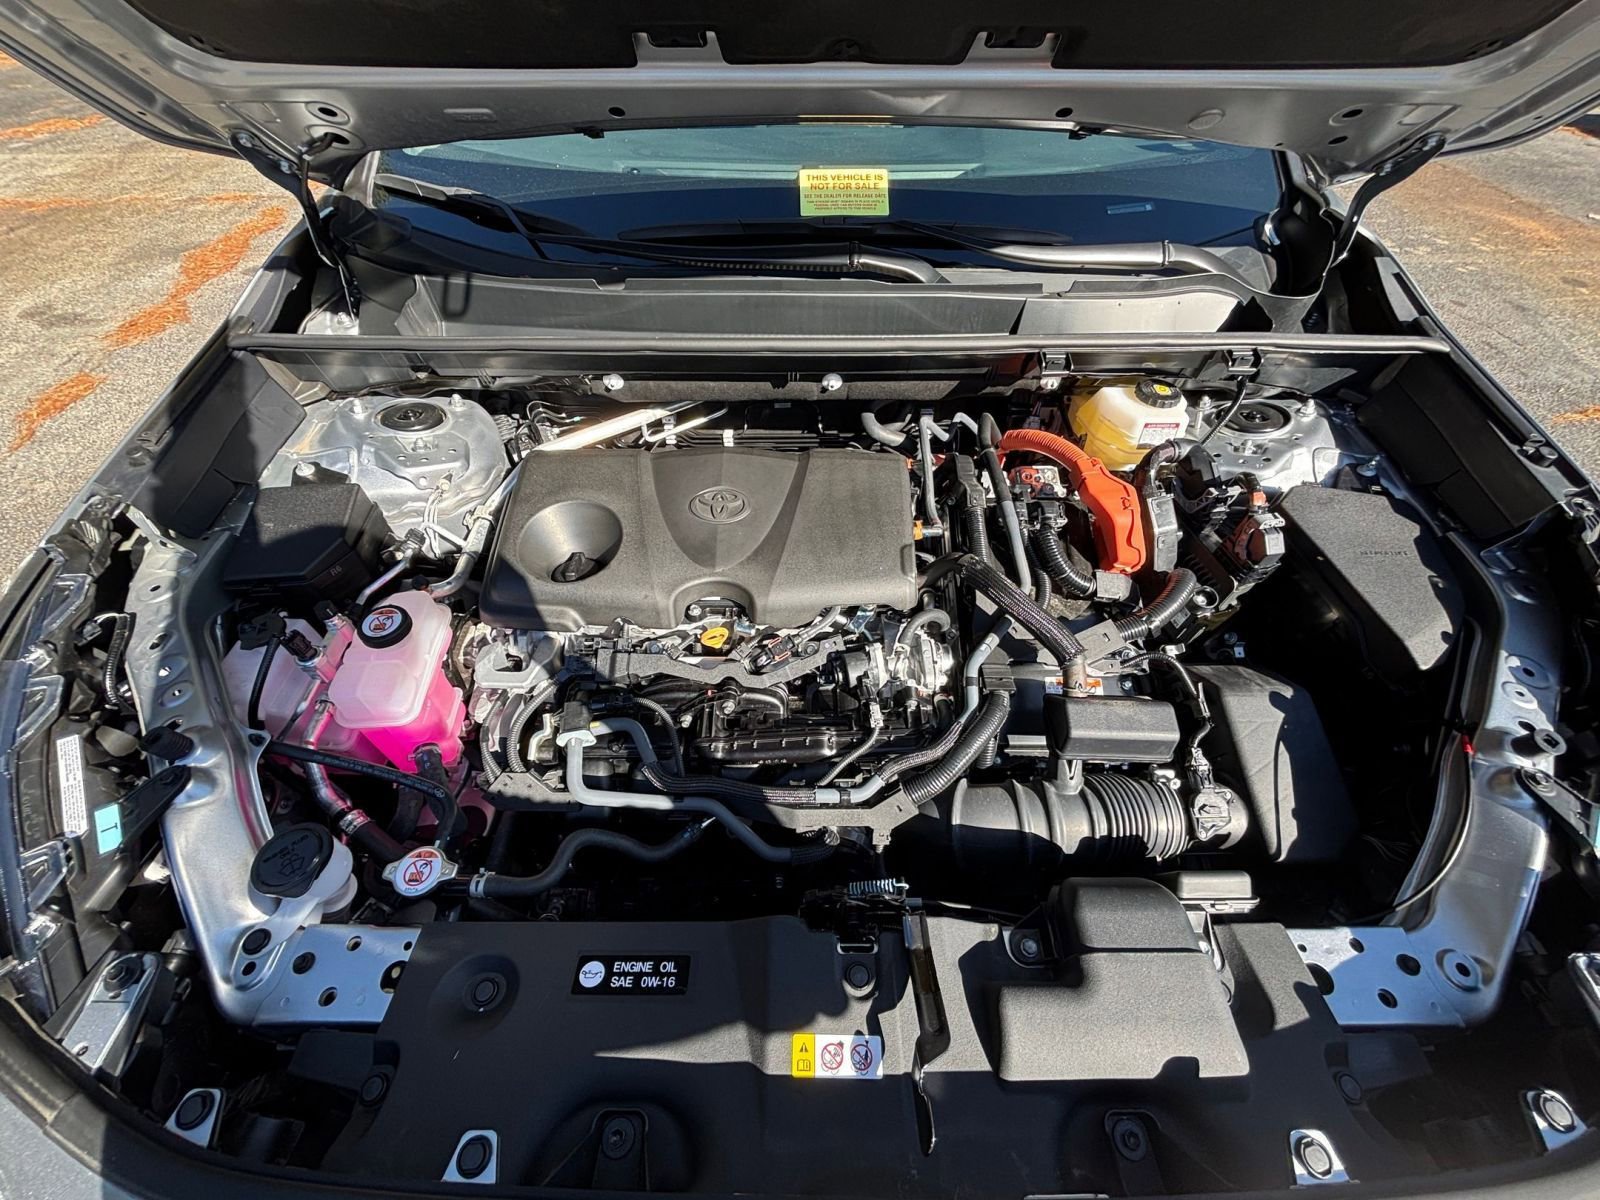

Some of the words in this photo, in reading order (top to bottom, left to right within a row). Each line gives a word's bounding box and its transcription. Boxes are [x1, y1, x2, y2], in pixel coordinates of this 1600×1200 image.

[810, 182, 831, 190] NOT
[832, 182, 852, 190] FOR
[854, 182, 880, 190] SALE
[613, 961, 654, 973] ENGINE
[660, 961, 678, 973] OIL
[610, 976, 634, 988] SAE
[641, 976, 676, 988] 0W-16
